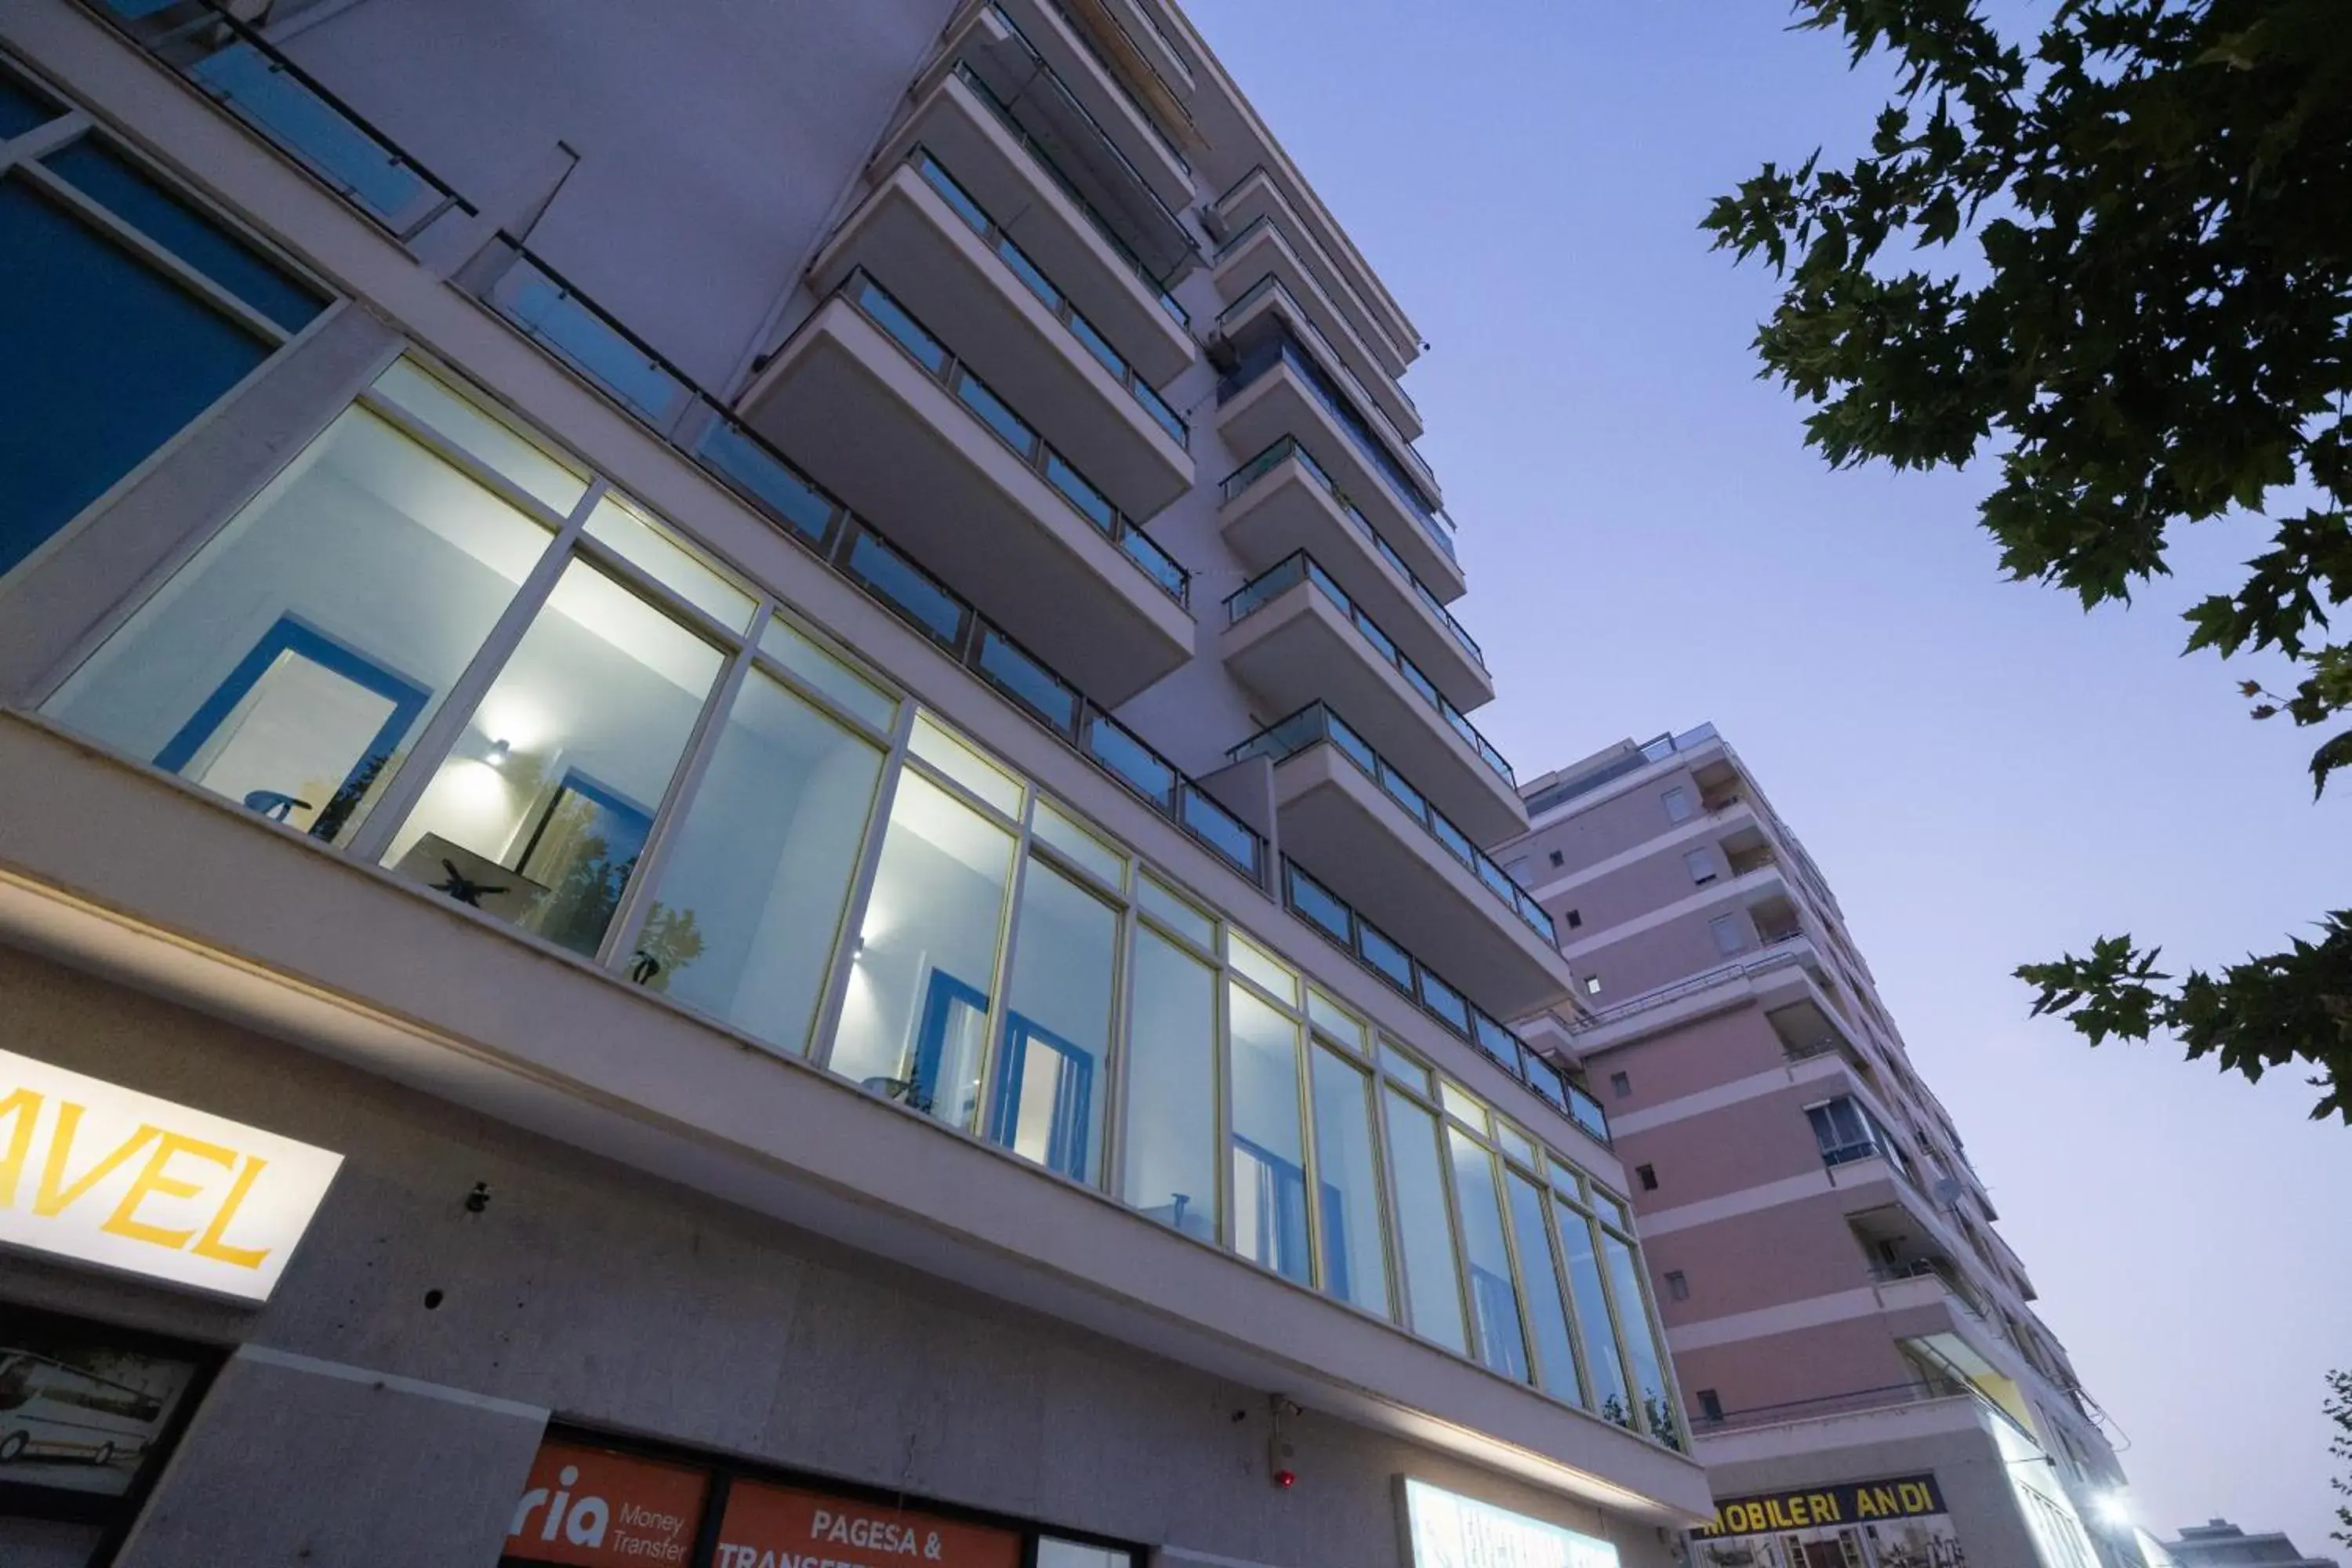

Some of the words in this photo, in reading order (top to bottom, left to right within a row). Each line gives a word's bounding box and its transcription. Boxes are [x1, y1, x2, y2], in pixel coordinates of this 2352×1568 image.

[506, 1465, 609, 1548] ria
[618, 1501, 685, 1536] Money
[1856, 1482, 1935, 1519] ANDI
[612, 1530, 688, 1562] Transfer
[810, 1509, 918, 1556] PAGESA
[924, 1531, 942, 1560] &
